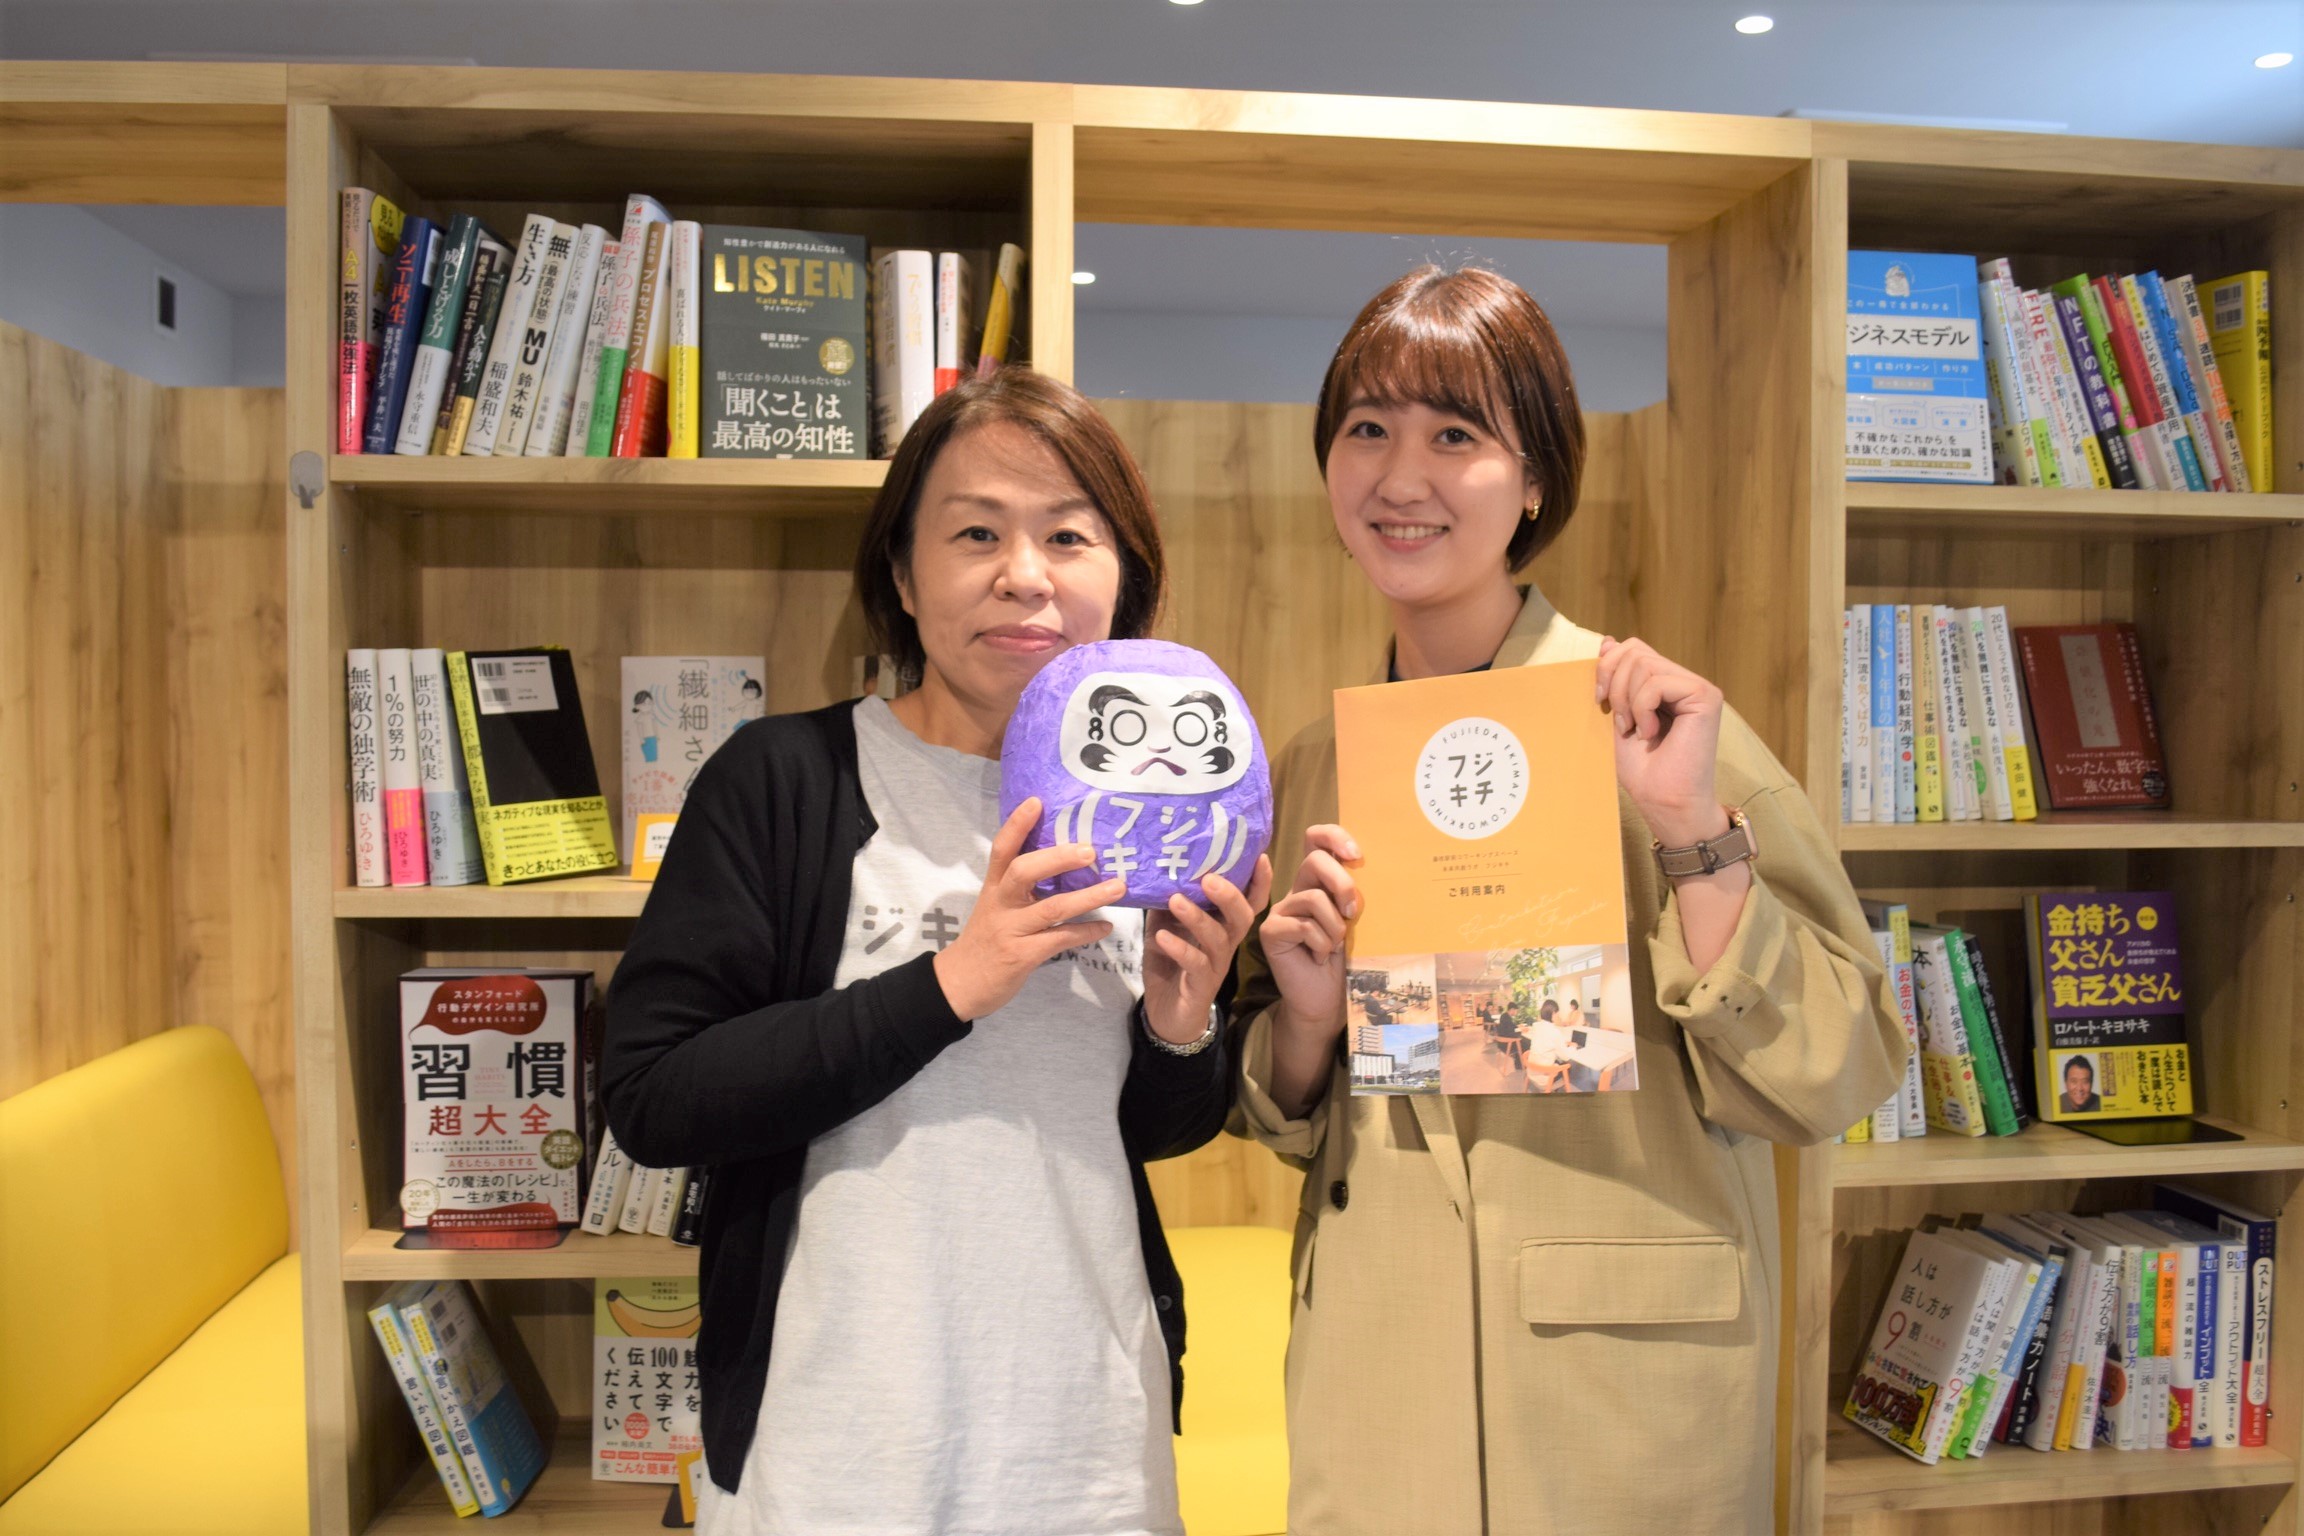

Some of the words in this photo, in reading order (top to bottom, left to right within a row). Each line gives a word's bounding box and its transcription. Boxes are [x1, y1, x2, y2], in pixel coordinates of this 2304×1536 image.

[514, 222, 546, 287] 生き方
[546, 234, 573, 260] 無
[386, 243, 417, 325] ソニー再生
[605, 225, 642, 337] 孫子の兵法
[713, 253, 855, 300] LISTEN
[626, 269, 657, 389] プロセスエコノミー
[1846, 324, 1971, 347] ジネスモデル
[2024, 292, 2048, 341] FIRE
[716, 370, 852, 387] 話してばかりの人はもったいない
[2064, 297, 2118, 428] NFTの教科書
[475, 361, 509, 437] 稲盛和夫
[509, 371, 534, 420] 鈴木祐
[720, 383, 842, 422] 「聞くこと」は
[712, 420, 855, 454] 最高の知性
[384, 674, 406, 763] 1%の努力
[414, 674, 438, 780] 世の中の真実
[1897, 672, 1913, 749] 行動経済学
[350, 666, 376, 804] 無敵の独学術
[1442, 726, 1499, 744] FUJIEDA
[1423, 754, 1437, 790] BASE
[1447, 752, 1494, 779] フジ
[1503, 743, 1521, 799] EKIMAE
[2055, 759, 2159, 776] いったん、数字に
[1449, 780, 1494, 809] キチ
[2082, 778, 2142, 794] 強くなれ。
[1108, 796, 1199, 844] フジ
[1428, 799, 1508, 831] COWORKING
[358, 812, 374, 871] ひろゆき
[430, 810, 444, 861] ひろゆき
[502, 851, 616, 879] きっとあなたの役に立つ
[1448, 884, 1506, 898] ご利用案内
[2046, 903, 2132, 938] 金持ち
[2048, 937, 2126, 972] 父さん
[437, 1001, 540, 1014] 行動デザイン研究所
[453, 989, 524, 999] スタンフォード
[2050, 972, 2182, 1009] 貧乏父さん
[2053, 1017, 2151, 1036] ロバート・キヨサキ
[2136, 1050, 2150, 1105] おきたい本
[2149, 1050, 2164, 1113] 一度は読んで
[2163, 1048, 2177, 1112] 人生について
[2176, 1048, 2187, 1082] お金と
[428, 1103, 553, 1137] 超大全
[449, 1158, 534, 1169] Aをしたら、Bをする
[452, 1189, 537, 1204] 一生が変わる
[1910, 1256, 1939, 1281] 人は
[2226, 1250, 2248, 1260] OUT
[2226, 1260, 2247, 1270] PUT
[1900, 1283, 1954, 1320] 話し方が
[2094, 1259, 2120, 1346] 伝え方が9割
[2183, 1277, 2196, 1360] 超一流の雑談力
[2254, 1263, 2270, 1360] ストレスフリー
[626, 1347, 645, 1410] 伝えて
[2225, 1320, 2240, 1405] アウトプット大全
[603, 1347, 621, 1431] ください
[650, 1346, 679, 1433] 100文字で
